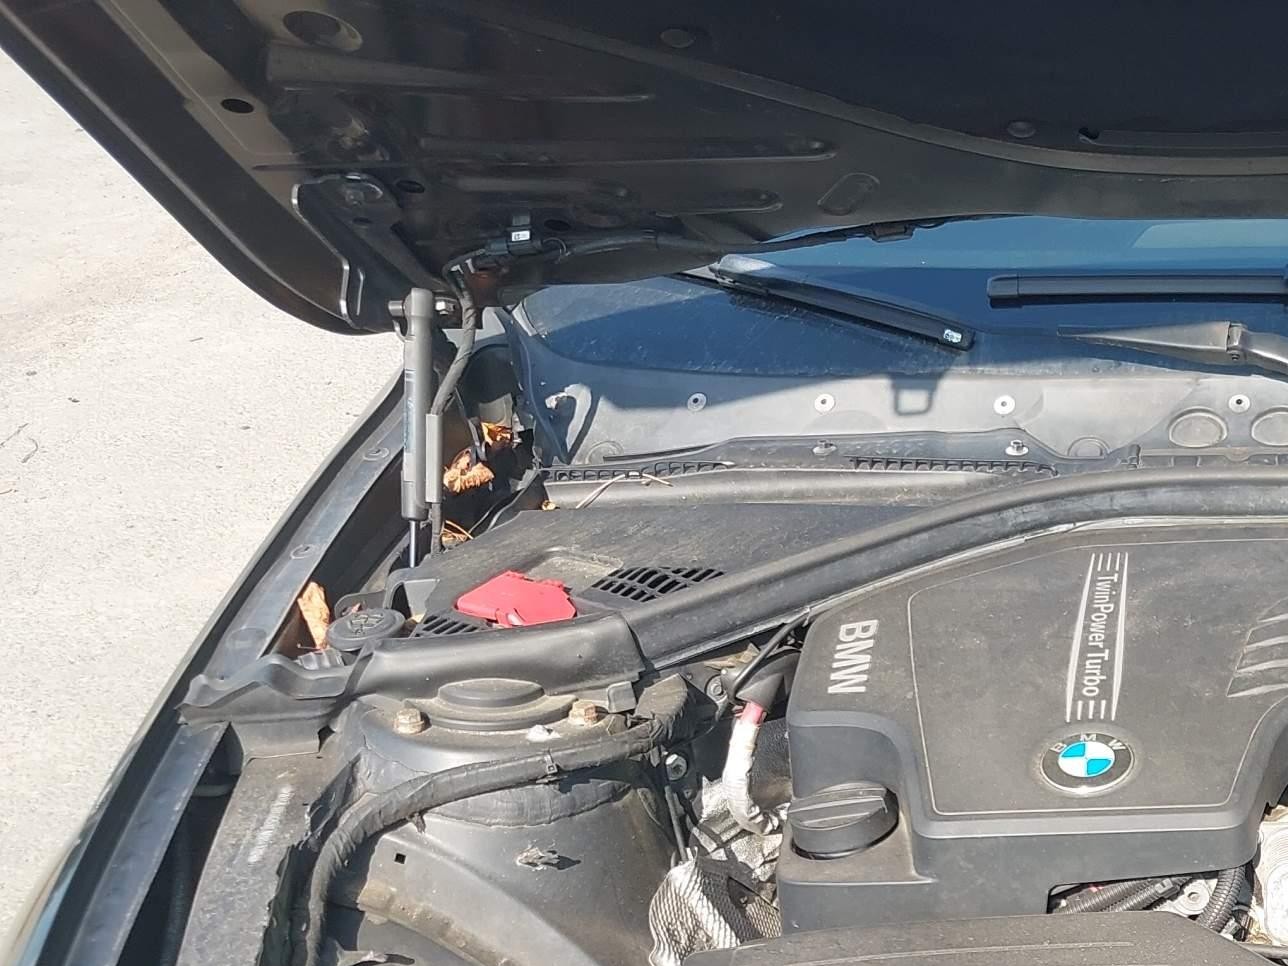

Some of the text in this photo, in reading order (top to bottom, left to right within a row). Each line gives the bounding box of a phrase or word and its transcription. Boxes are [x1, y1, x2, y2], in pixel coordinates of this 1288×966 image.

[827, 618, 879, 695] BMW
[1081, 572, 1119, 697] TwinPower Turbo
[1049, 733, 1126, 754] BMW
